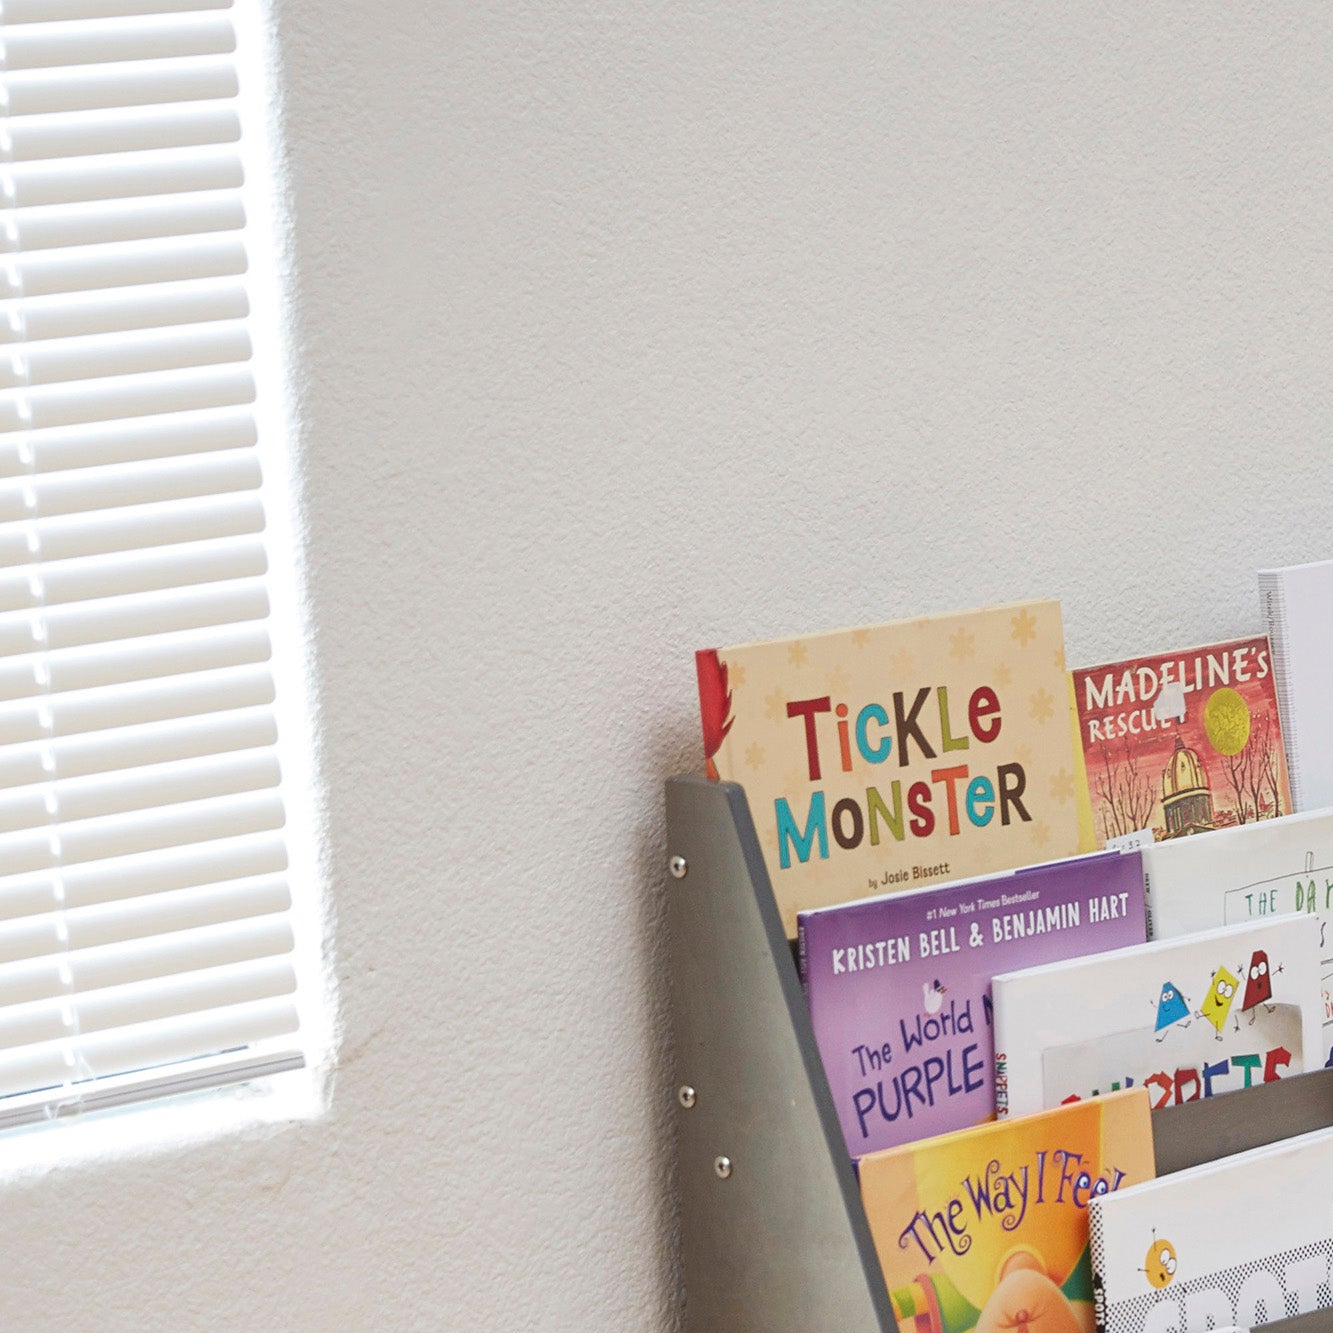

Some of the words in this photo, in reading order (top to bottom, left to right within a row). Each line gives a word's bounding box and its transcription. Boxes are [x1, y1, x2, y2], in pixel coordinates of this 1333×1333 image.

[868, 878, 878, 890] by
[881, 868, 909, 887] Josie
[912, 862, 951, 881] Bissett
[926, 908, 938, 921] #1
[938, 907, 957, 919] New
[959, 902, 976, 915] York
[977, 898, 1000, 911] Times
[1001, 890, 1040, 906] Bestseller
[1244, 888, 1279, 916] THE
[831, 936, 911, 975] KRISTEN
[919, 926, 961, 958] BELL
[968, 922, 985, 948] &
[992, 900, 1082, 944] BENJAMIN
[1088, 892, 1130, 923] HART
[852, 1043, 892, 1078] The
[899, 1000, 975, 1053] World
[852, 1043, 985, 1139] PURPLE
[898, 1198, 972, 1265] The
[962, 1159, 1028, 1232] Way
[1035, 1150, 1049, 1205] I
[1052, 1149, 1127, 1209] Feel
